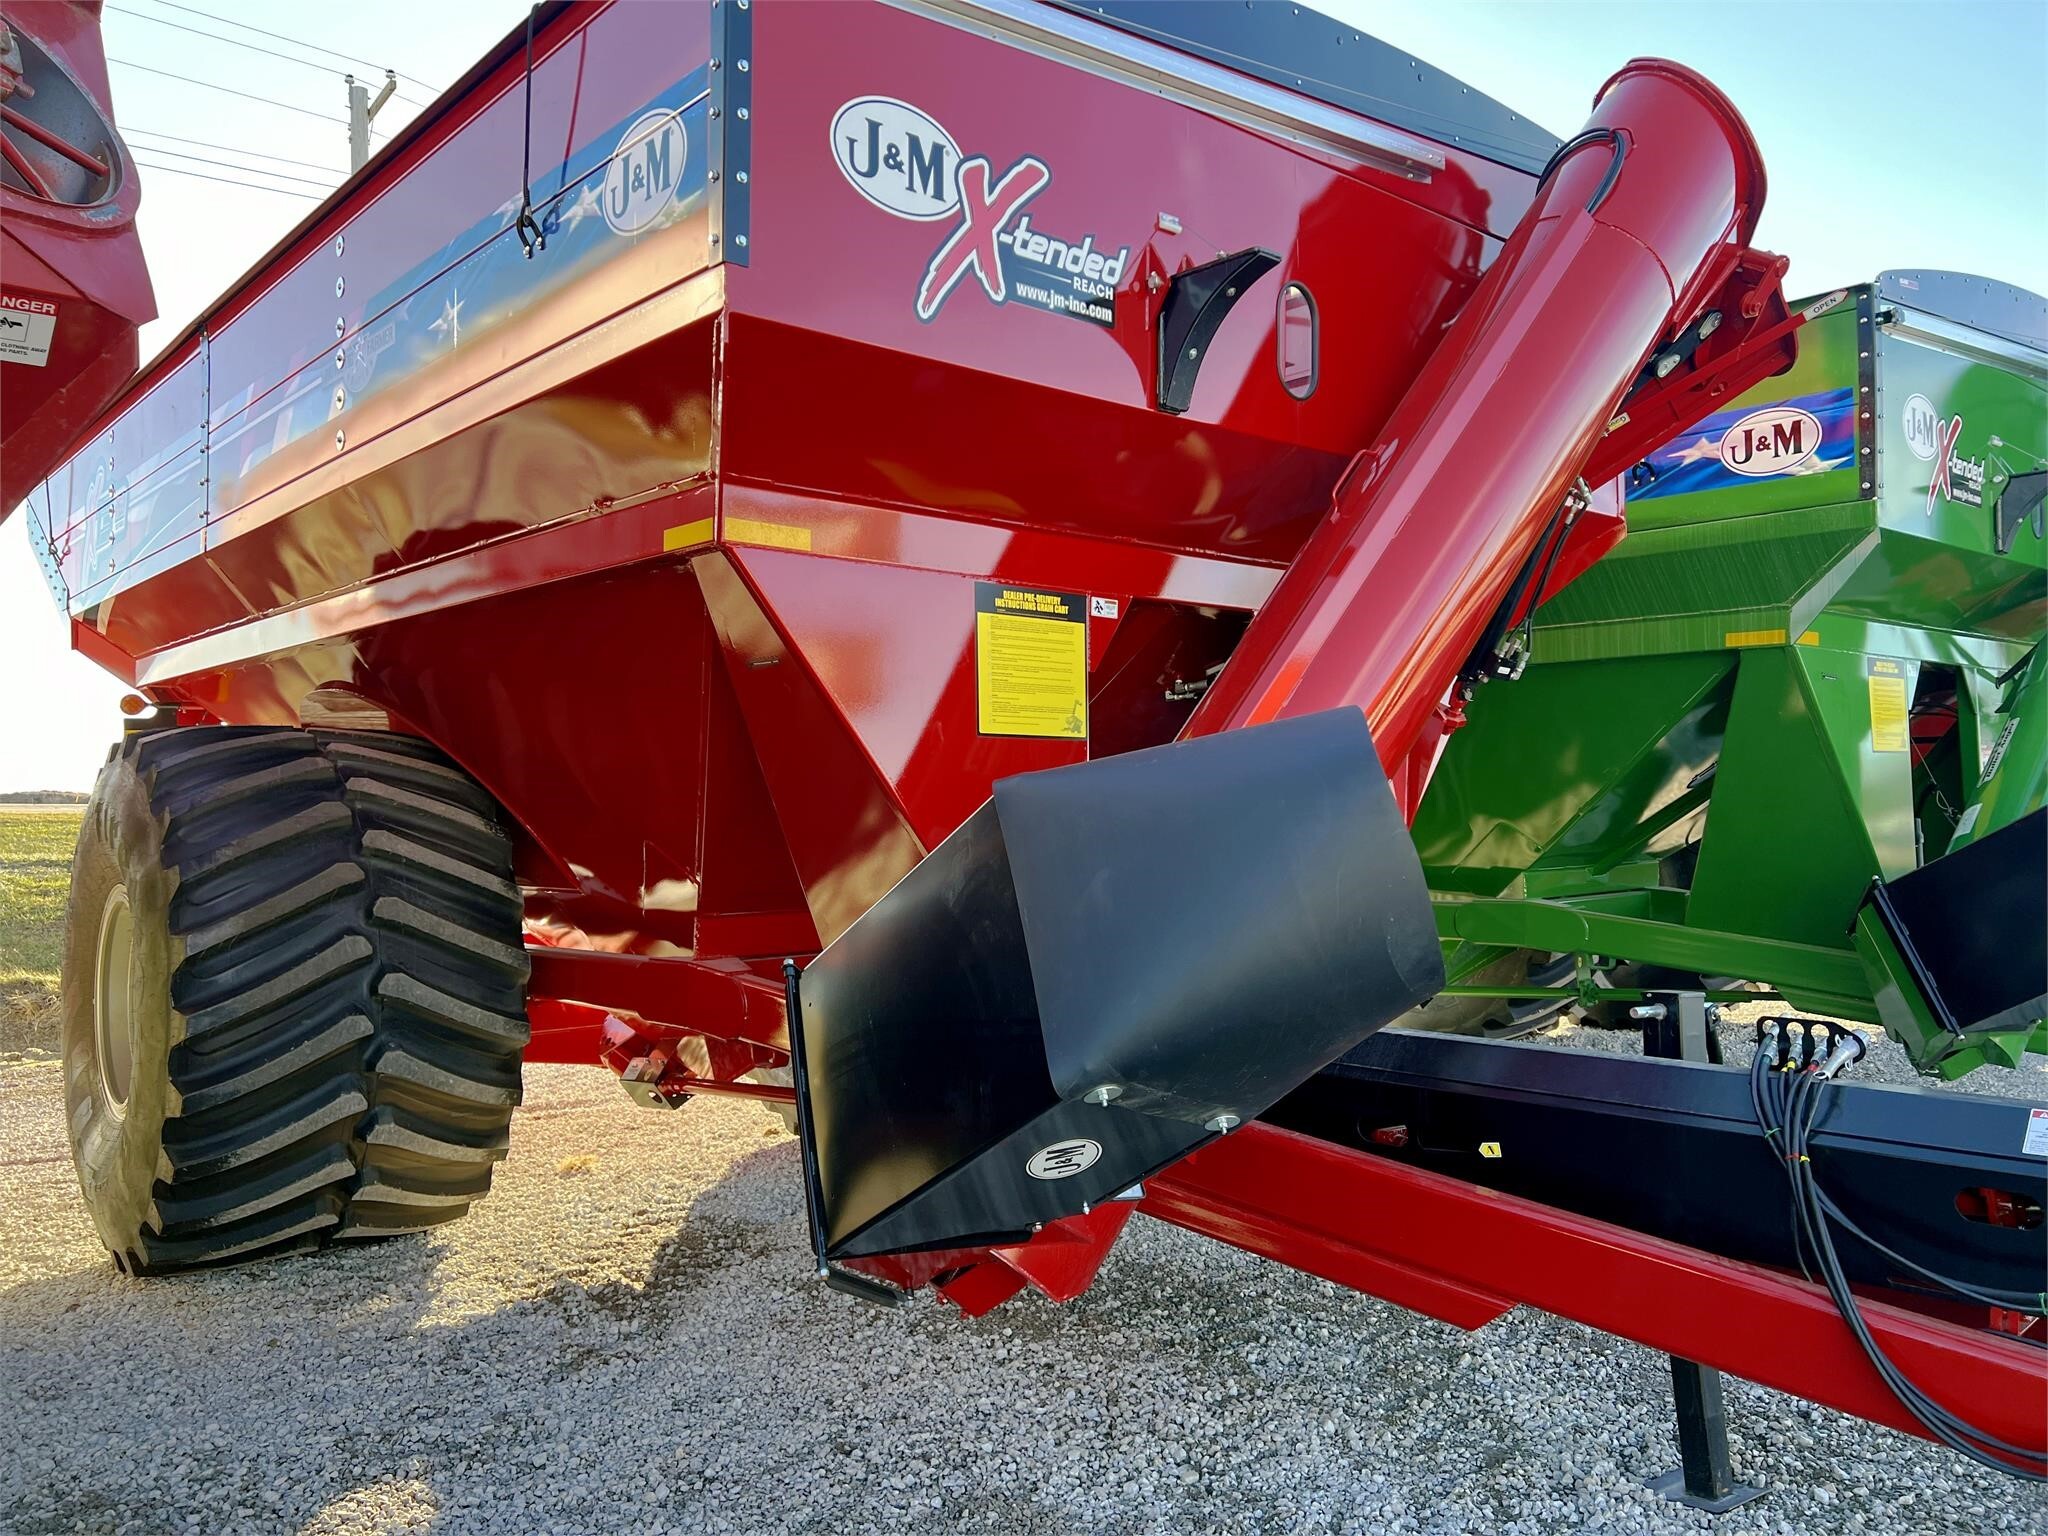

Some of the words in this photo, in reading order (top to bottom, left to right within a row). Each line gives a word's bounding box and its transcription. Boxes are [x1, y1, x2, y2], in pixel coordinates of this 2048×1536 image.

[611, 126, 672, 219] J&M
[846, 117, 946, 202] J&M
[1016, 282, 1113, 322] www.jm-inc.com
[1073, 276, 1113, 300] REACH
[2, 296, 56, 314] NGER
[1813, 297, 1837, 313] OPEN
[1730, 419, 1804, 465] J&M
[1907, 407, 1935, 448] J&M
[995, 598, 1036, 611] INSTRUCTIONS
[1055, 605, 1069, 614] CART
[1003, 590, 1023, 600] DEALER
[1043, 1144, 1086, 1174] J&M
